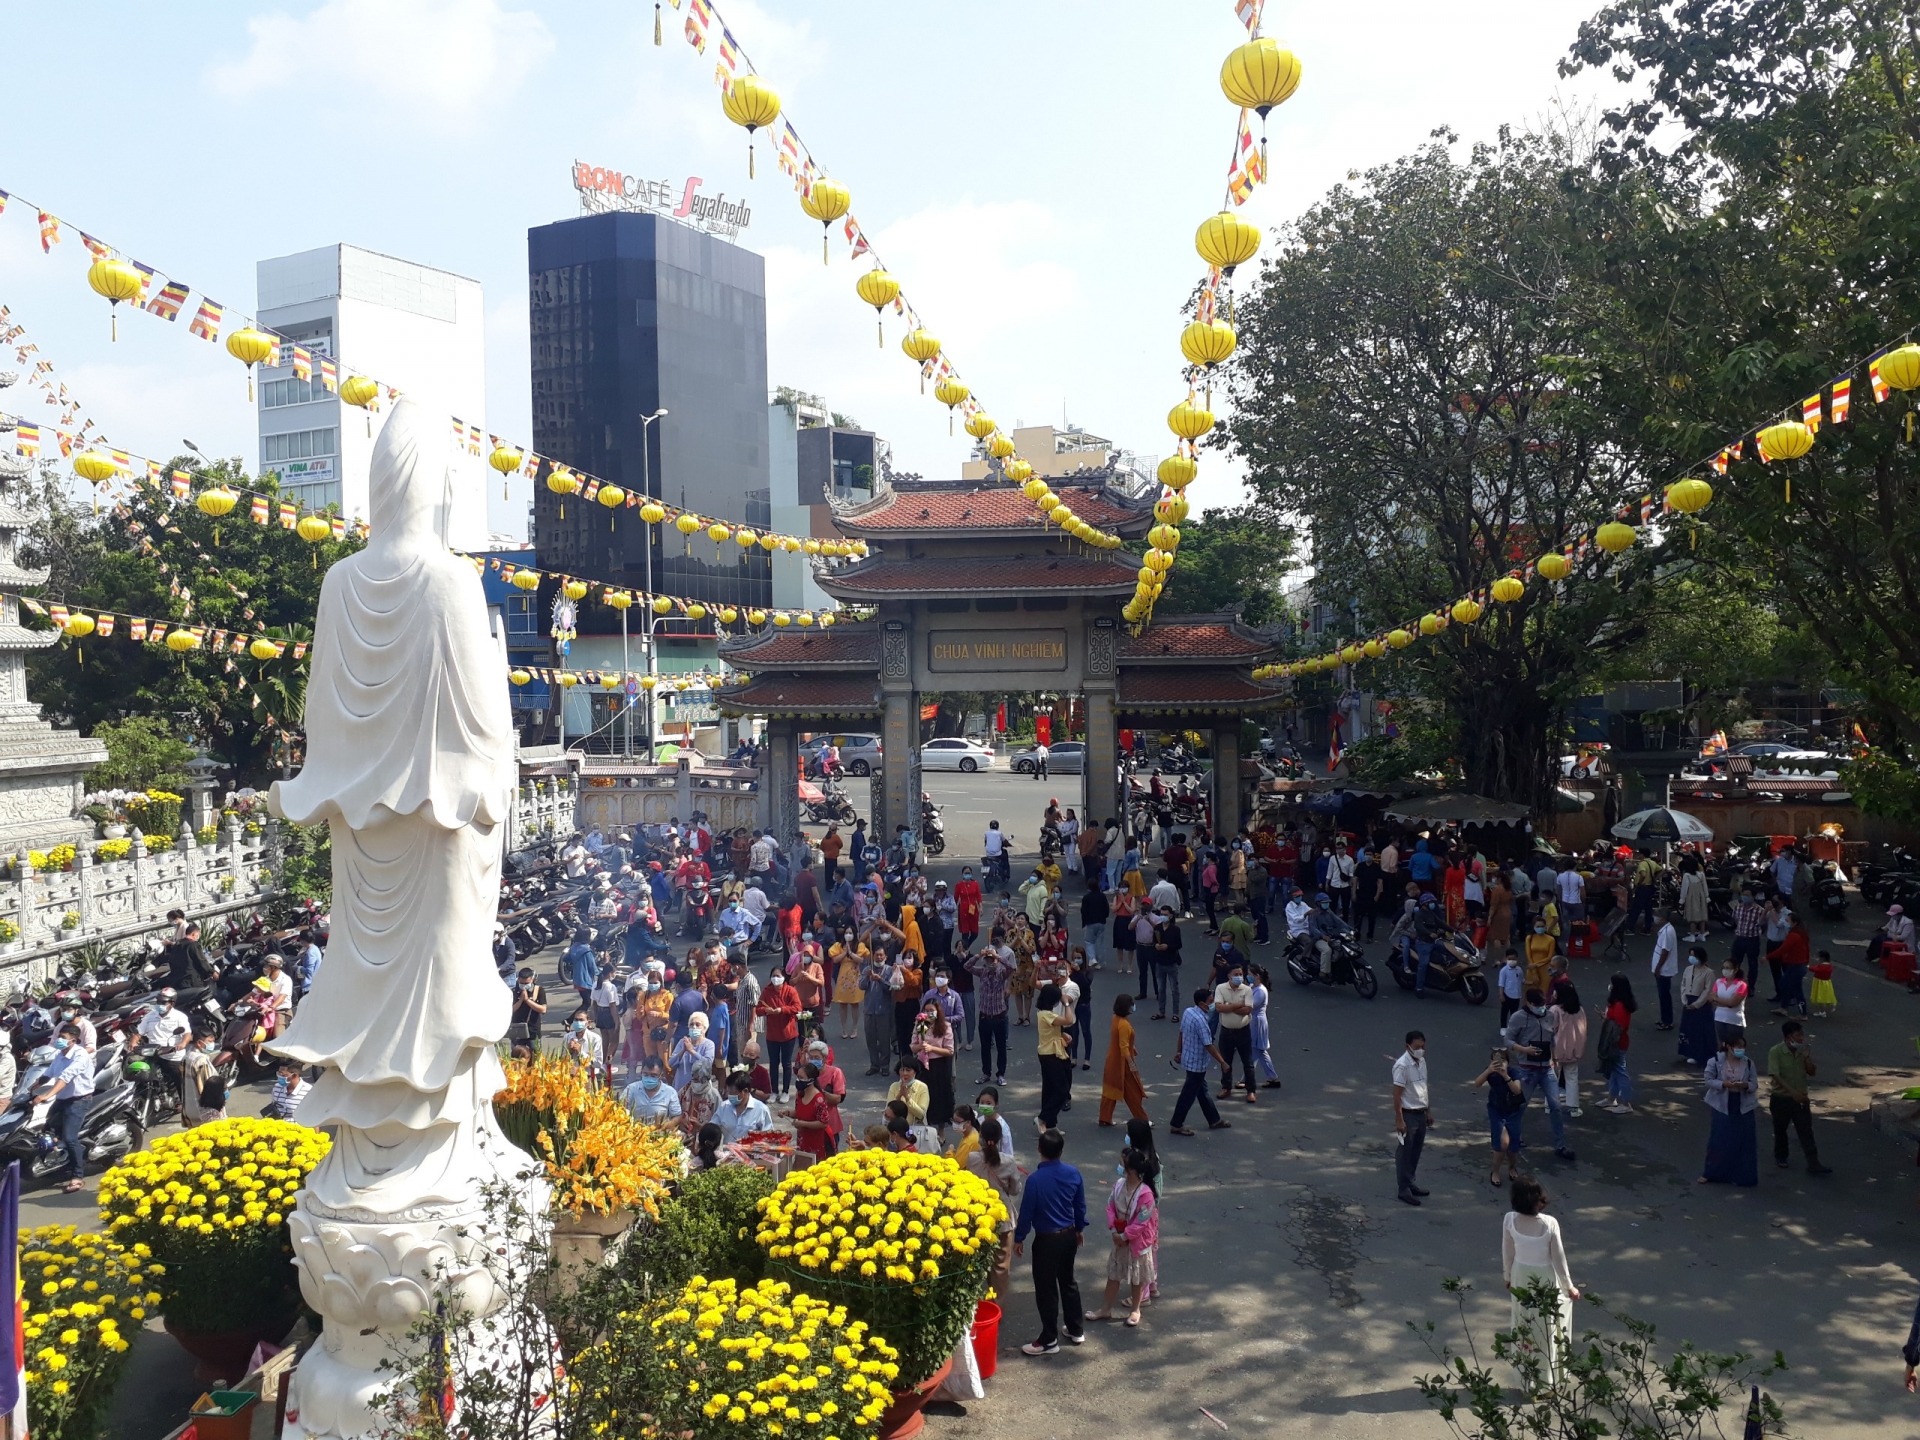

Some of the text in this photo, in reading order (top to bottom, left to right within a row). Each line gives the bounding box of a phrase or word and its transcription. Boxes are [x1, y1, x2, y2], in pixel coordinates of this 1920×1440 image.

[673, 176, 751, 228] Segafredo
[289, 463, 308, 473] VINA
[934, 640, 970, 659] CHÙA
